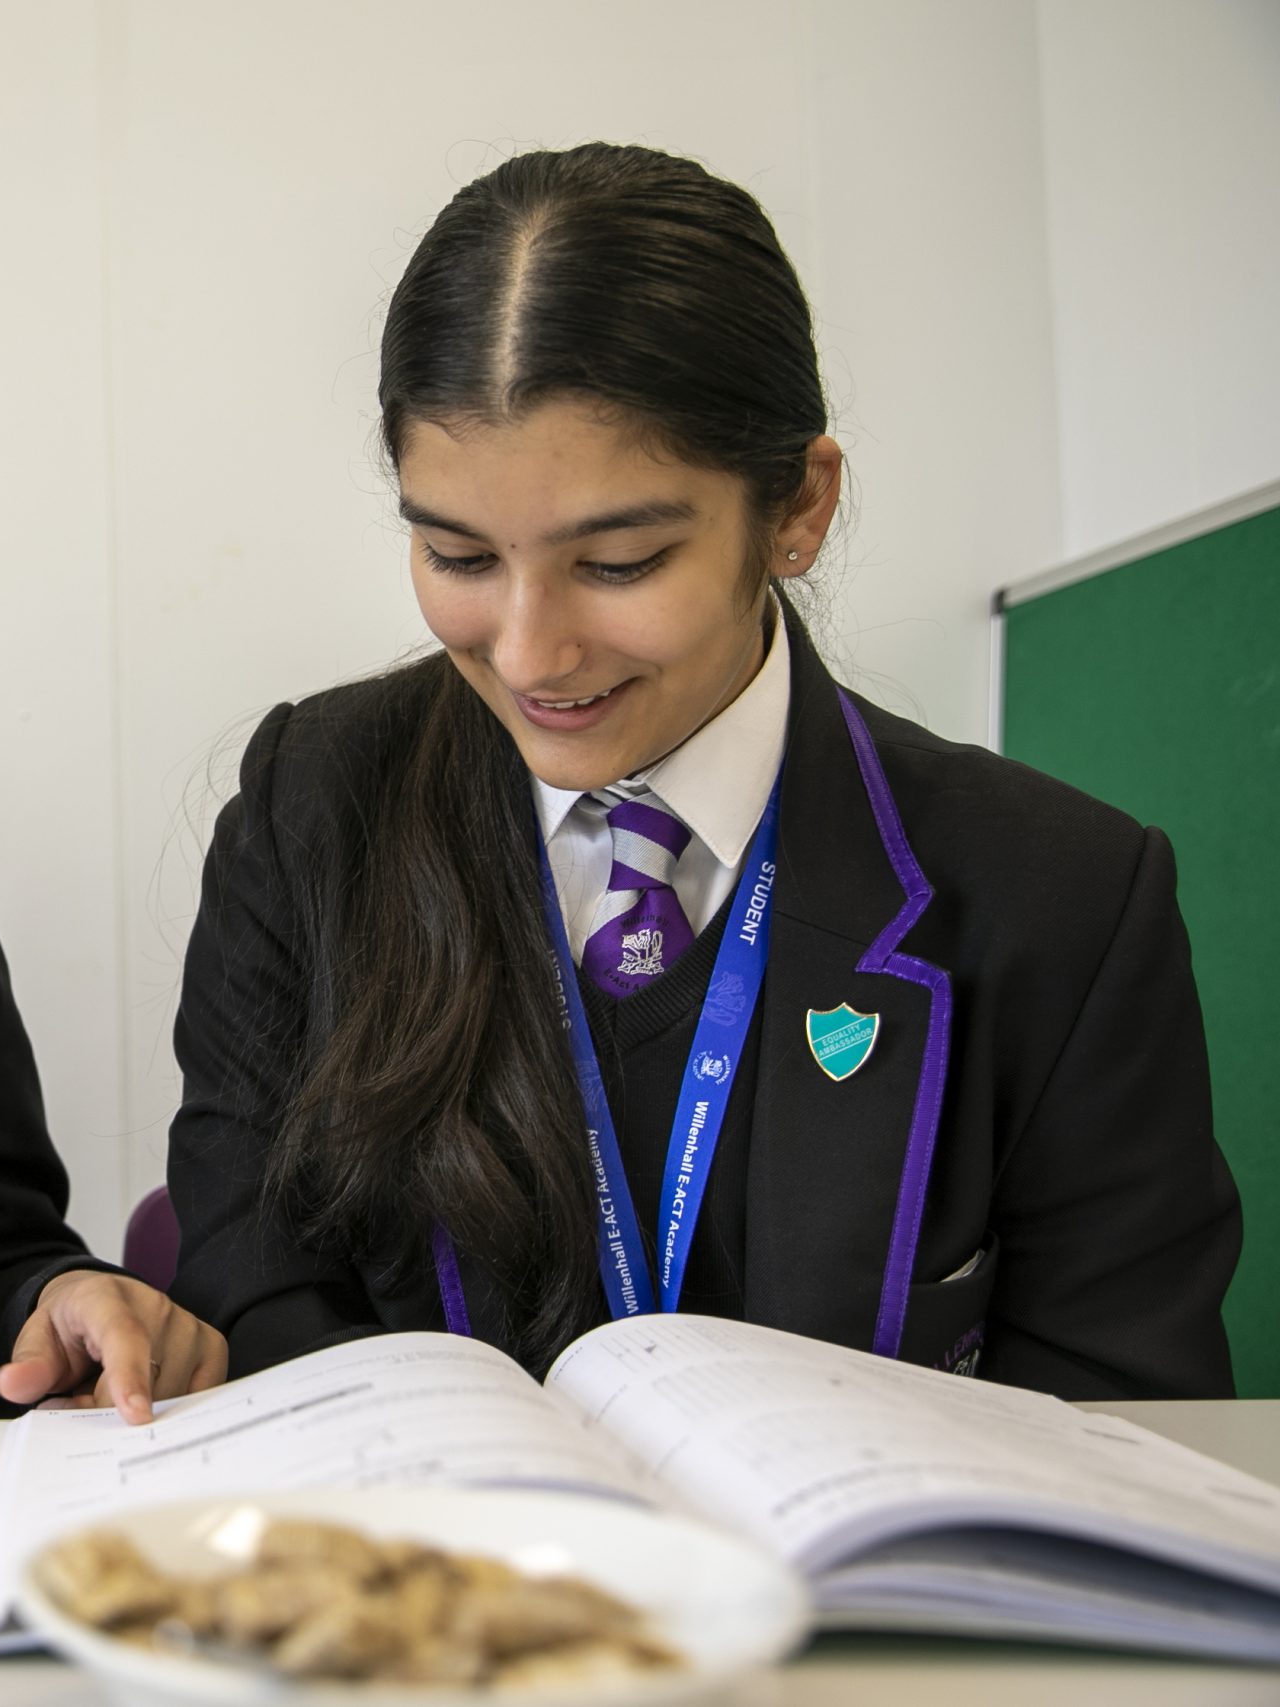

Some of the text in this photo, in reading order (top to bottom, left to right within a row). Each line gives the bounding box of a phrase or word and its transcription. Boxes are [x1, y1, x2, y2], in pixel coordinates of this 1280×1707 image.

[739, 861, 776, 945] STUDENT
[819, 1028, 872, 1056] AMBASSADOR
[822, 1024, 860, 1046] EQUALITY
[587, 1129, 639, 1315] Willenhall E-ACT Academy
[662, 1101, 709, 1289] Willenhall E-ACT Academy
